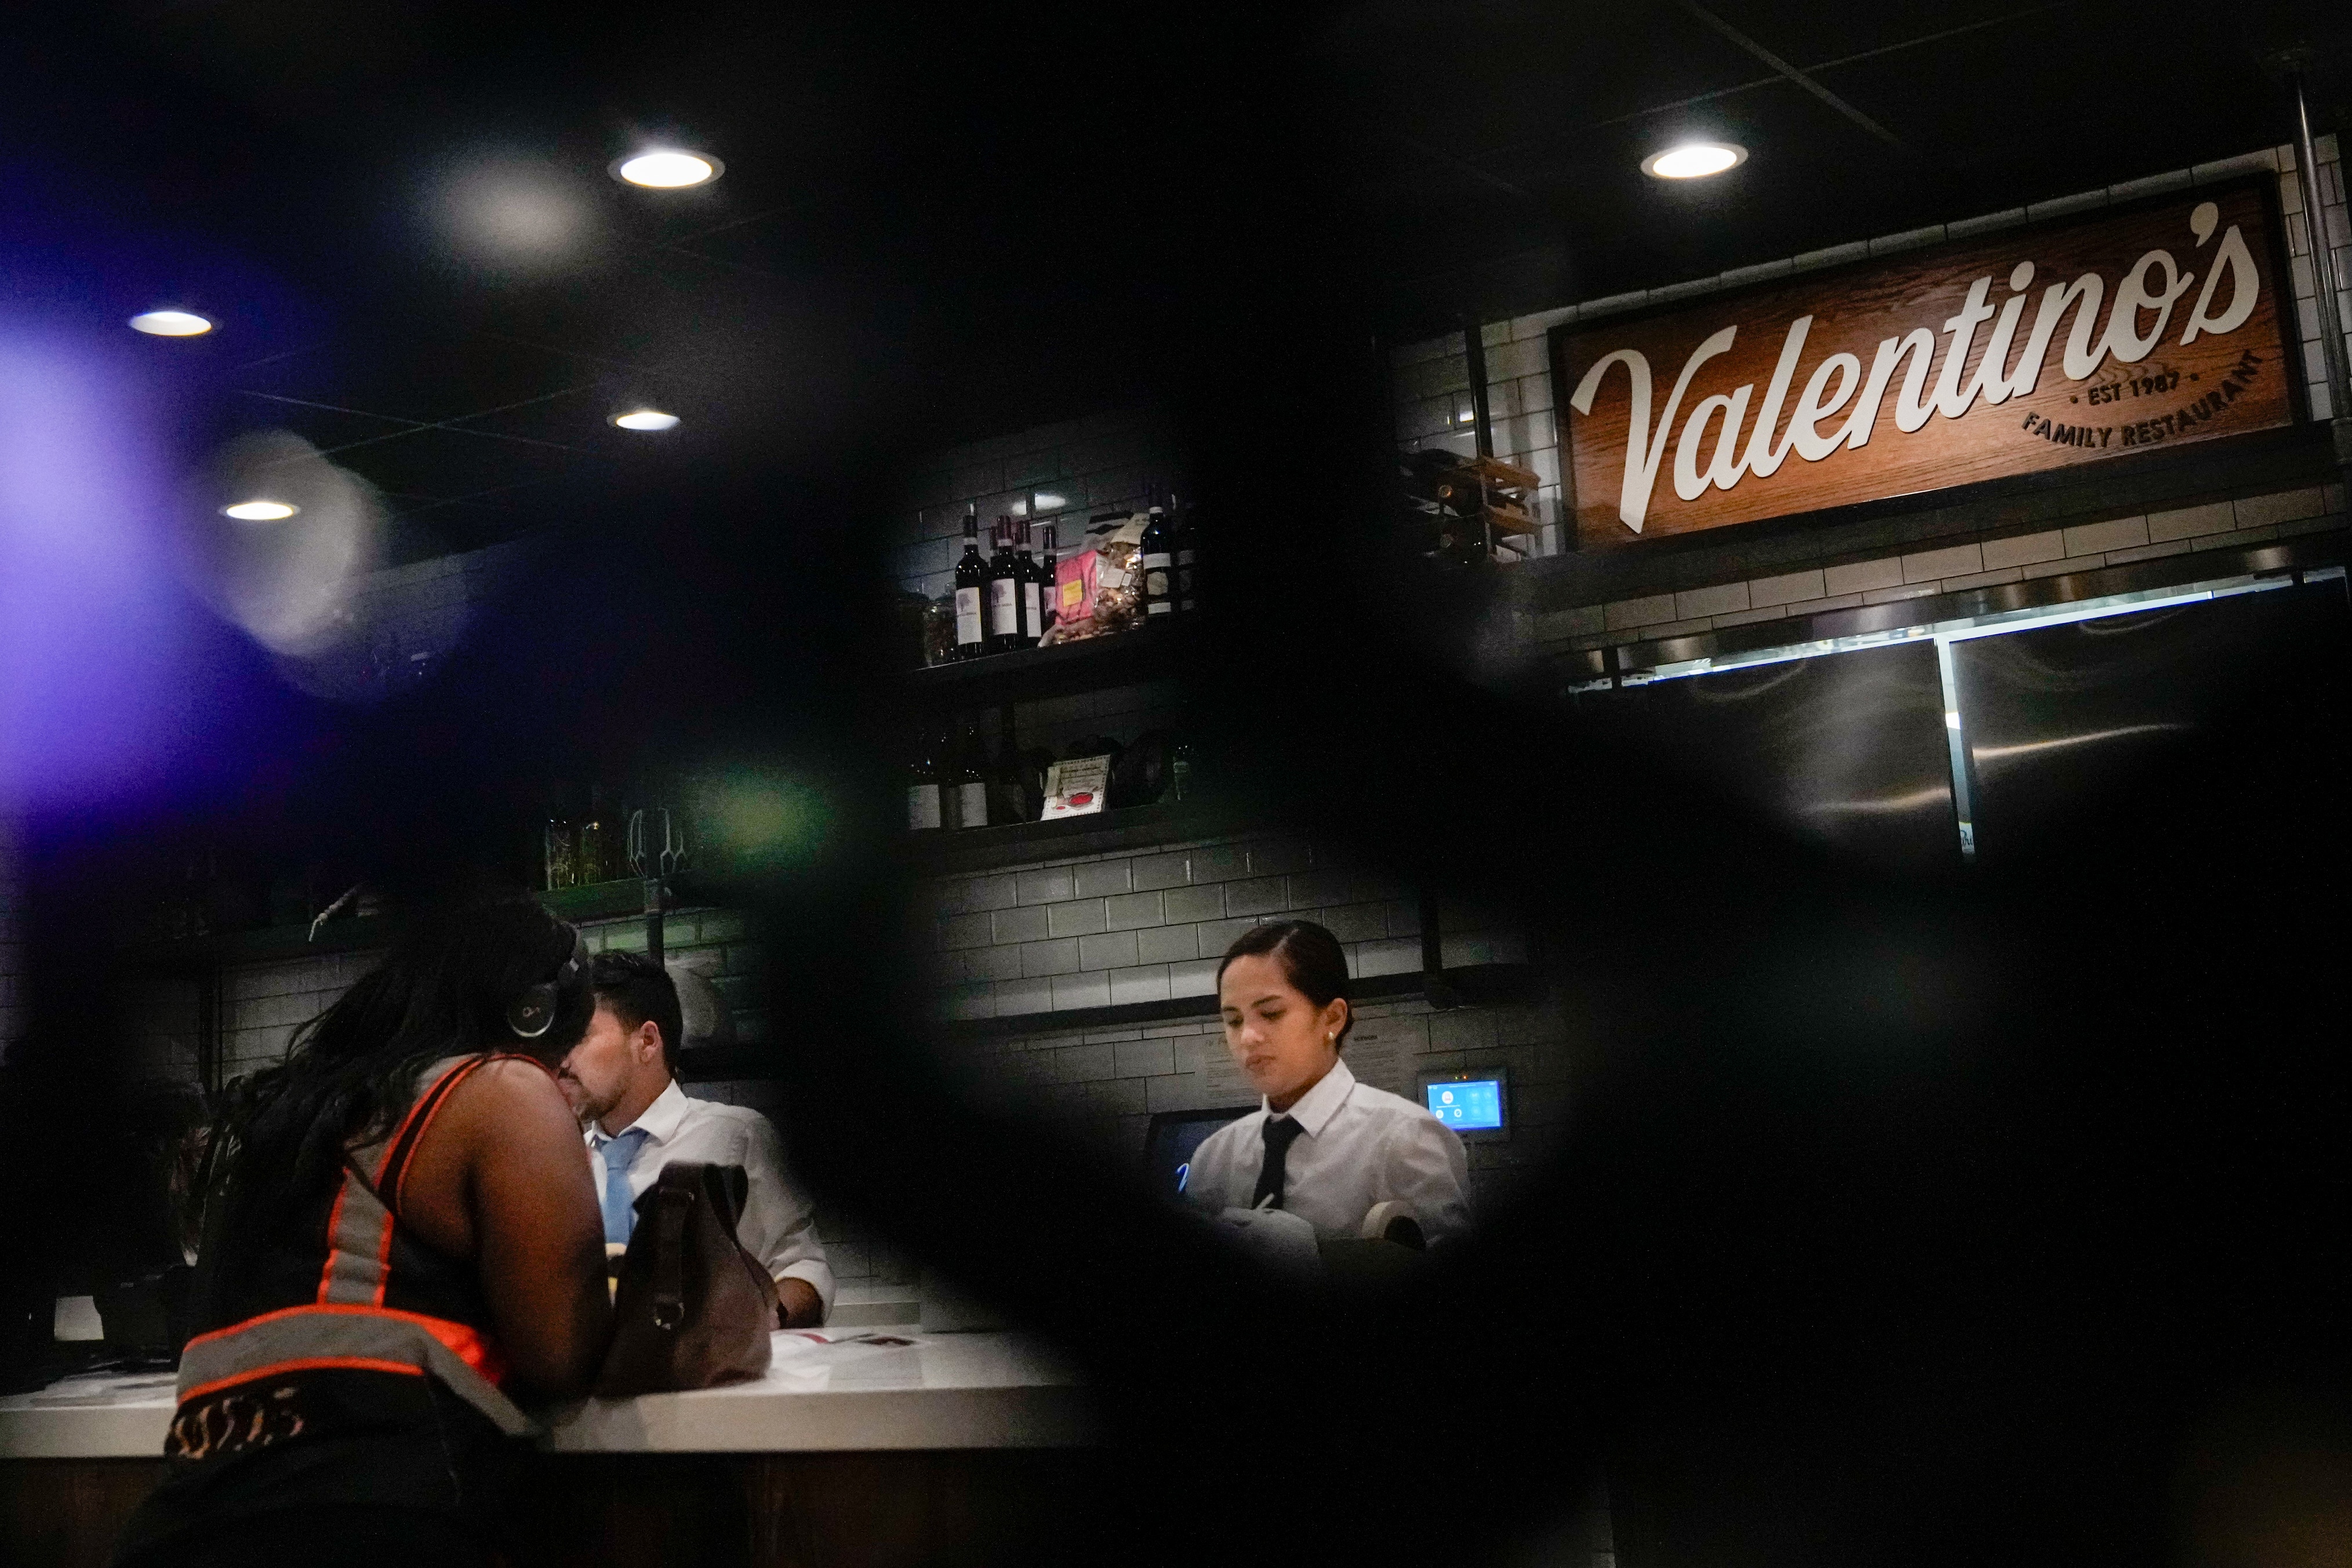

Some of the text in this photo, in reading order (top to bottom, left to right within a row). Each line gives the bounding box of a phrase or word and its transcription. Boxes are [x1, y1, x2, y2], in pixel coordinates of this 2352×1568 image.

[1569, 201, 2260, 533] Valentino's
[2021, 349, 2263, 448] FAMILY RESTAURANT
[2088, 370, 2180, 406] EST 1987
